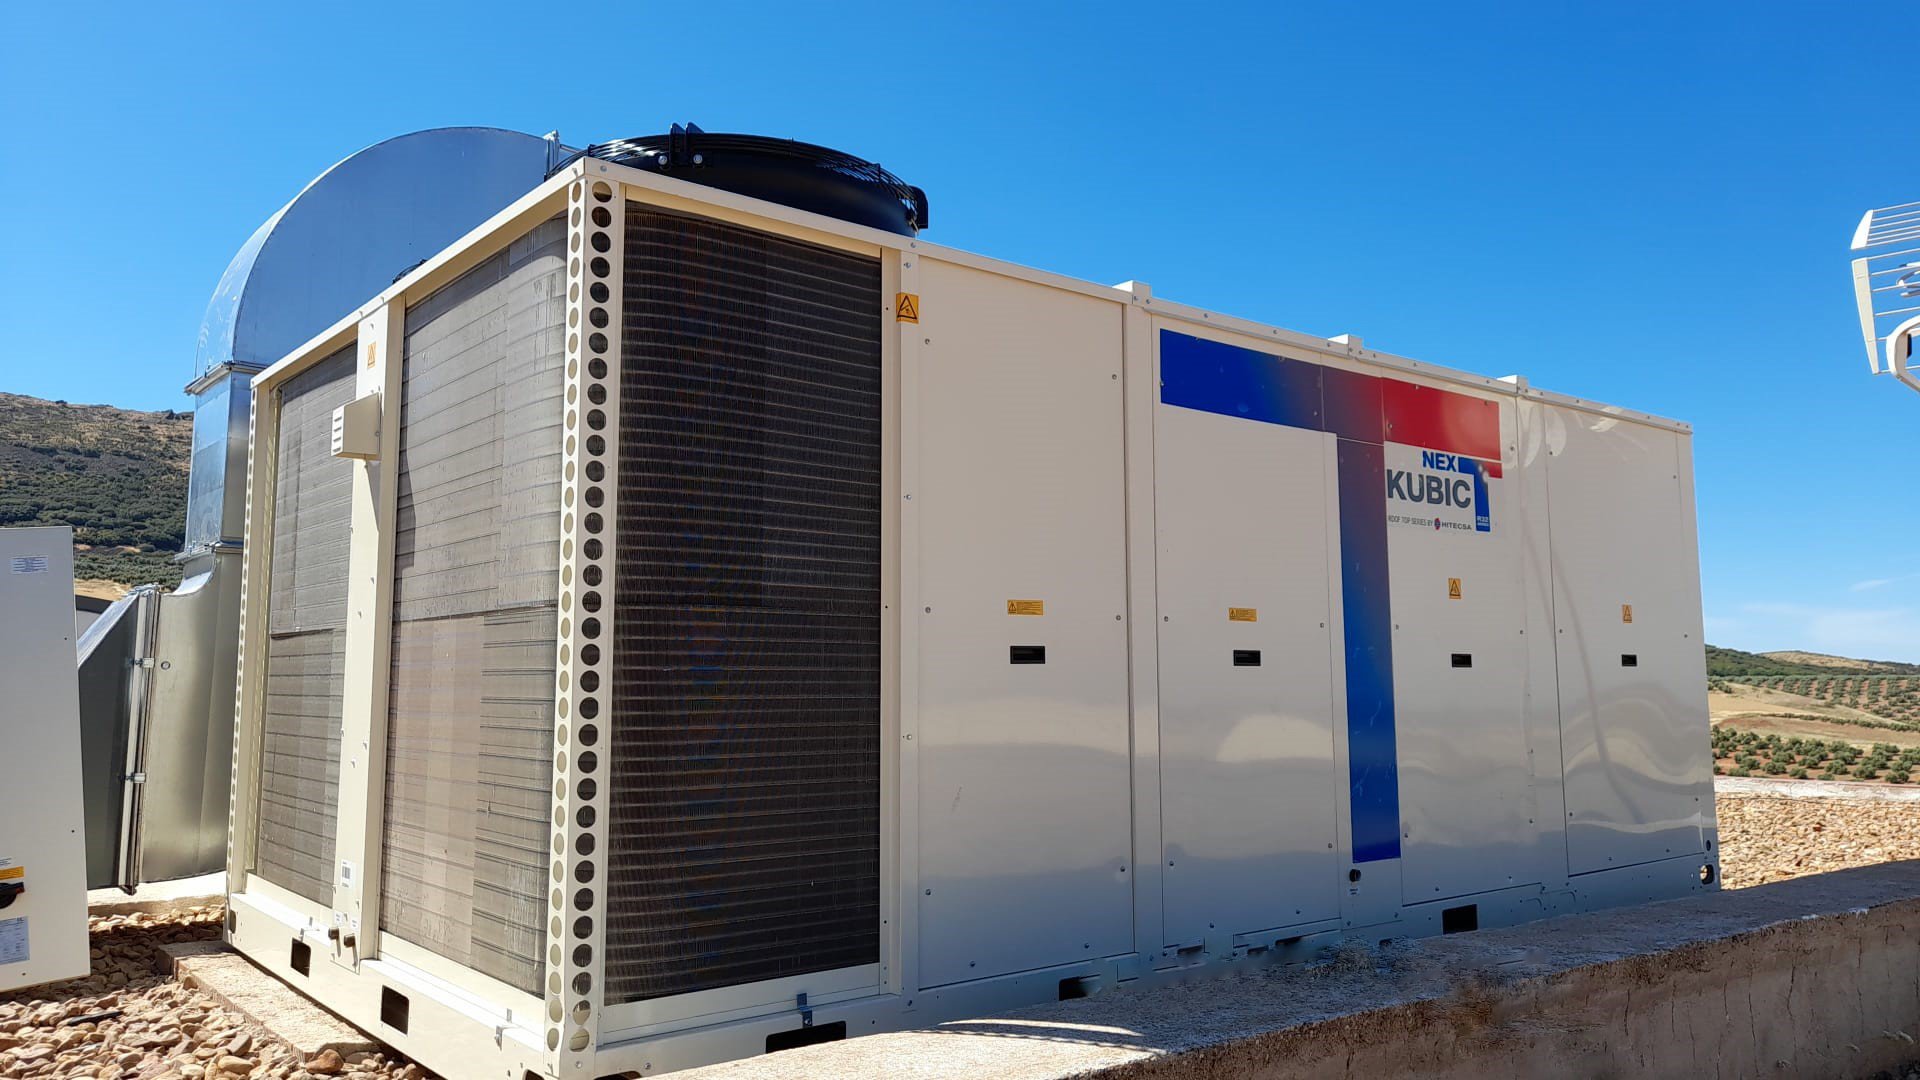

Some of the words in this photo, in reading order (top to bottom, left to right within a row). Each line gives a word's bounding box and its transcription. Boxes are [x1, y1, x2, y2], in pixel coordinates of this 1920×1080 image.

[1422, 450, 1456, 472] NEX
[1387, 469, 1471, 508] KUBIC
[1402, 516, 1410, 524] TOP
[1441, 521, 1472, 530] HITECSA
